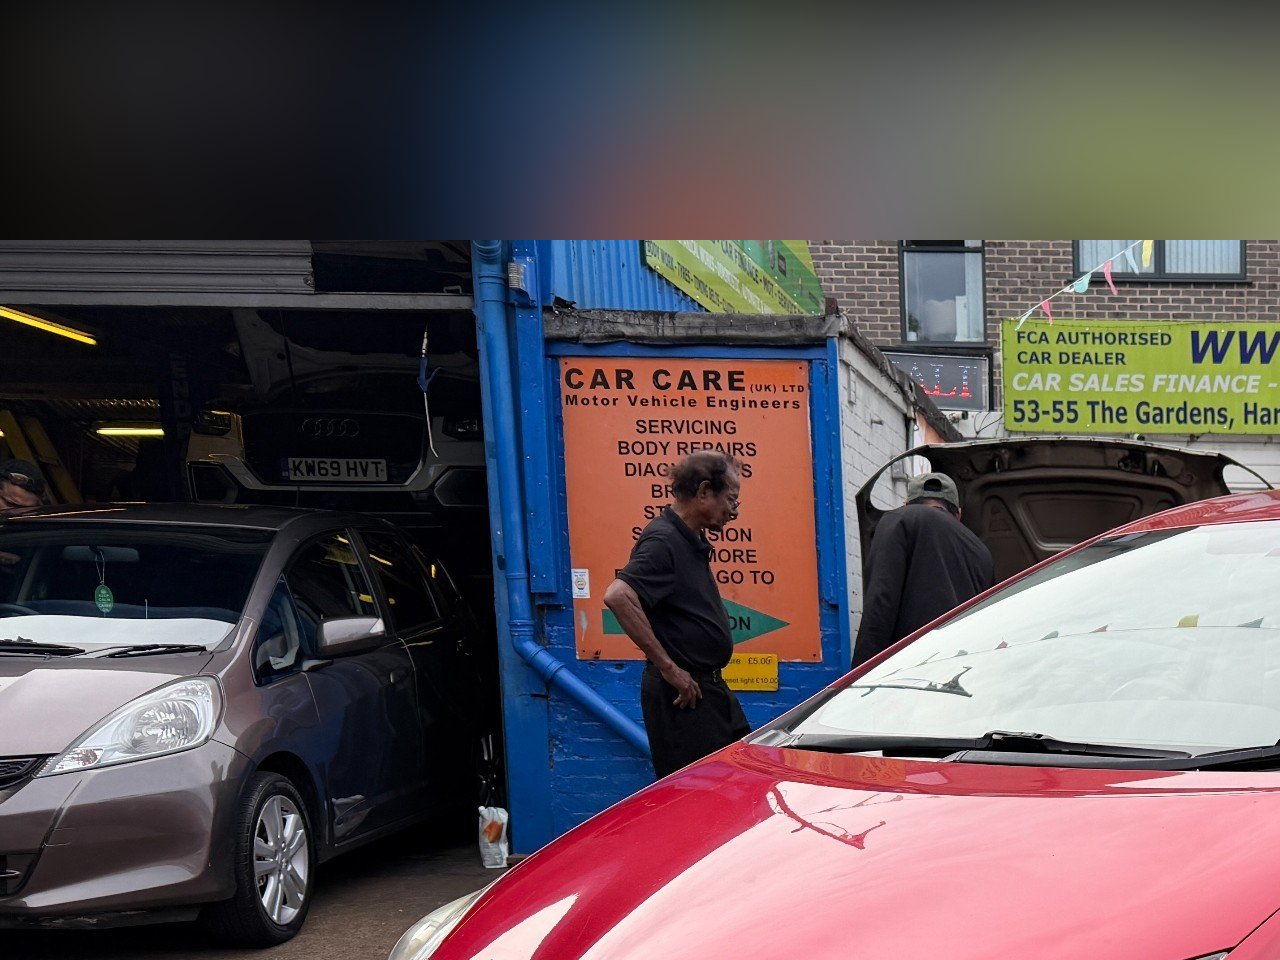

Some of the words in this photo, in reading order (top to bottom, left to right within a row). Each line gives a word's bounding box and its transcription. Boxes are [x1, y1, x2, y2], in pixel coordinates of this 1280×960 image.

[1017, 331, 1054, 346] FCA
[1056, 331, 1172, 346] AUTHORISED
[1017, 351, 1054, 365] CAR
[1058, 351, 1126, 365] DEALER
[565, 368, 635, 389] CAR
[652, 369, 745, 391] CARE
[750, 384, 777, 393] (UK)
[783, 385, 804, 393] LTD
[1012, 373, 1061, 392] CAR
[1067, 374, 1145, 393] SALES
[1152, 374, 1261, 394] FINANCE
[565, 395, 619, 406] Motor
[627, 395, 697, 407] Vehicle
[706, 396, 800, 411] Engineers
[1012, 400, 1079, 424] 53-55
[1086, 400, 1128, 424] The
[1136, 401, 1234, 430] Gardens,
[636, 419, 737, 434] SERVICING
[618, 441, 670, 455] BODY
[292, 460, 340, 477] KW69
[346, 460, 381, 478] HVT
[717, 570, 744, 584] GO
[750, 570, 774, 585] TO
